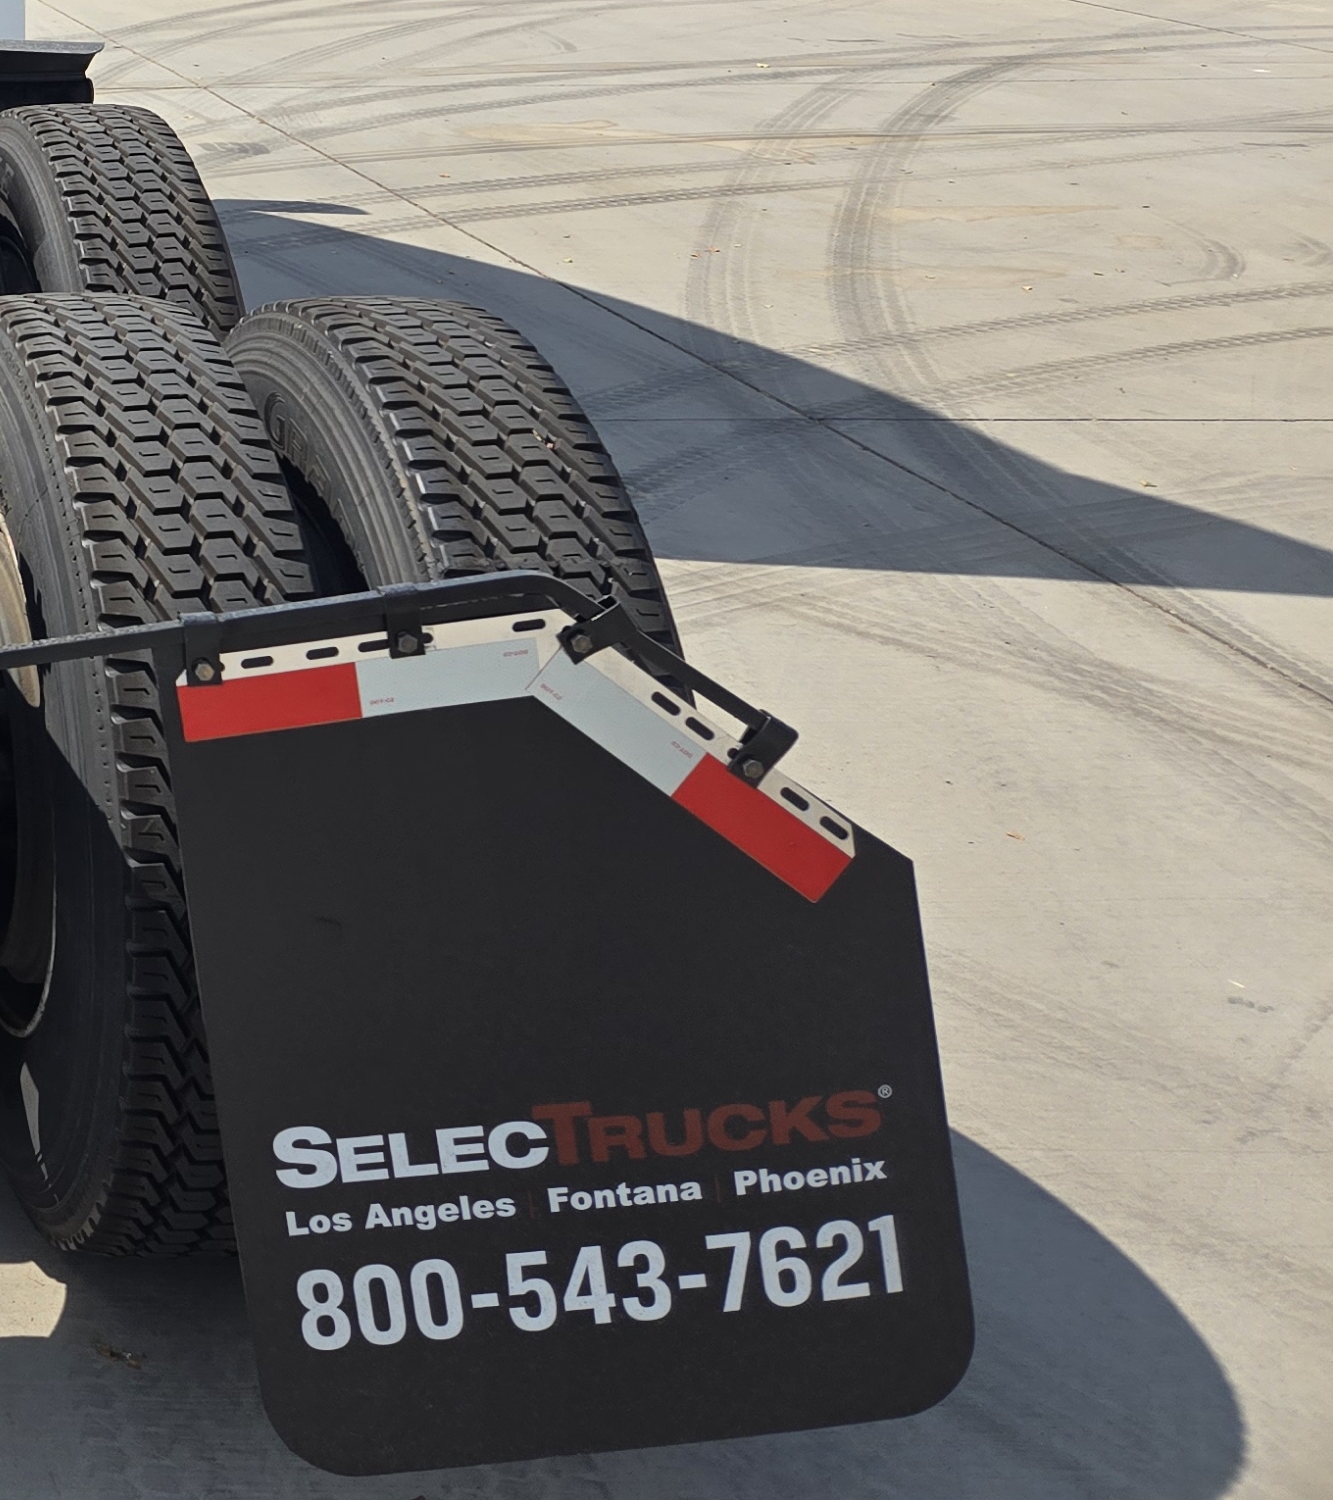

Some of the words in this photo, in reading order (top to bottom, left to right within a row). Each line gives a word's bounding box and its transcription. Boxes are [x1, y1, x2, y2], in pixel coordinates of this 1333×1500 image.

[285, 1209, 352, 1236] Los
[365, 1194, 517, 1231] Angeles
[547, 1179, 703, 1213] Fontana
[733, 1156, 888, 1196] Phoenix
[296, 1214, 905, 1351] 800-543-7621
